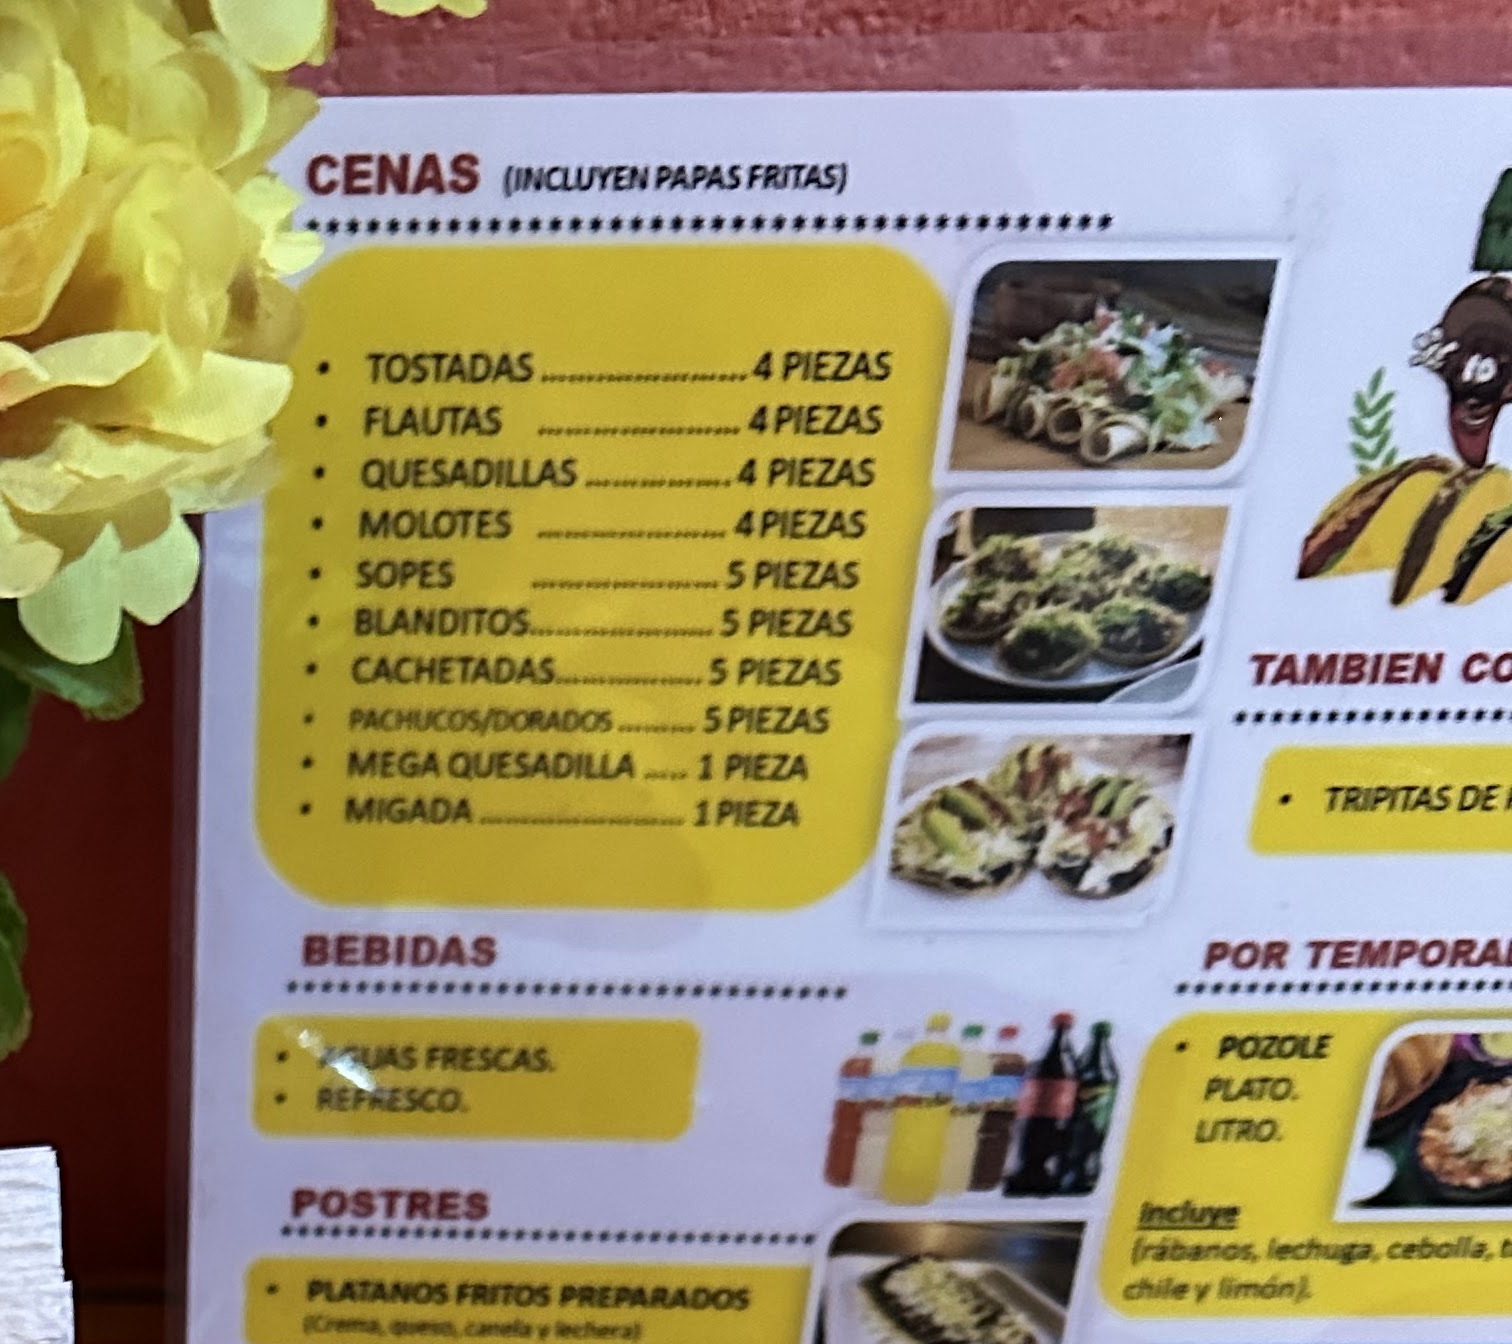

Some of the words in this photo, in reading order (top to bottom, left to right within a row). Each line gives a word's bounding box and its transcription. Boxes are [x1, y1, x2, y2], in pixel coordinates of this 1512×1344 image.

[306, 153, 480, 197] CENAS
[503, 164, 650, 195] (INCLUYEN
[655, 164, 742, 192] PAPAS
[746, 163, 849, 194] FRITAS)
[367, 352, 534, 384] TOSTADAS
[752, 353, 774, 383] 4
[782, 351, 892, 384] PIEZAS
[364, 407, 502, 437] FLAUTAS
[748, 406, 770, 436] 4
[775, 405, 883, 436] PIEZAS
[361, 458, 578, 489] QUESADILLAS
[737, 459, 757, 486] 4
[769, 457, 876, 487] PIEZAS
[359, 510, 512, 539] MOLOTES
[734, 510, 754, 537] 4
[761, 509, 867, 538] PIEZAS
[356, 560, 455, 589] SOPES
[726, 560, 746, 588] 5
[754, 559, 860, 588] PIEZAS
[354, 608, 530, 637] BLANDITOS
[722, 608, 740, 636] 5
[746, 608, 853, 636] PIEZAS
[352, 657, 556, 686] CACHETADAS
[709, 659, 727, 685] 5
[738, 658, 842, 686] PIEZAS
[1249, 653, 1445, 685] TAMBIEN
[348, 707, 613, 737] PACHUCOS/DORADOS
[703, 706, 721, 733] 5
[727, 706, 830, 735] PIEZAS
[347, 752, 440, 780] MEGA
[447, 753, 635, 782] QUESADILLA
[698, 755, 713, 780] 1
[724, 754, 809, 782] PIEZA
[344, 797, 473, 827] MIGADA
[692, 800, 709, 827] 1
[715, 799, 800, 828] PIEZA
[1325, 785, 1452, 812] TRIPITAS
[1457, 784, 1500, 811] DE
[301, 934, 499, 967] BEBIDAS
[1203, 941, 1289, 970] POR
[1217, 1033, 1334, 1060] POZOLE
[1203, 1076, 1299, 1102] PLATO.
[291, 1189, 489, 1221] POSTRES
[306, 1278, 448, 1308] PLATANOS
[455, 1281, 552, 1308] FRITOS
[559, 1285, 750, 1312] PREPARADOS
